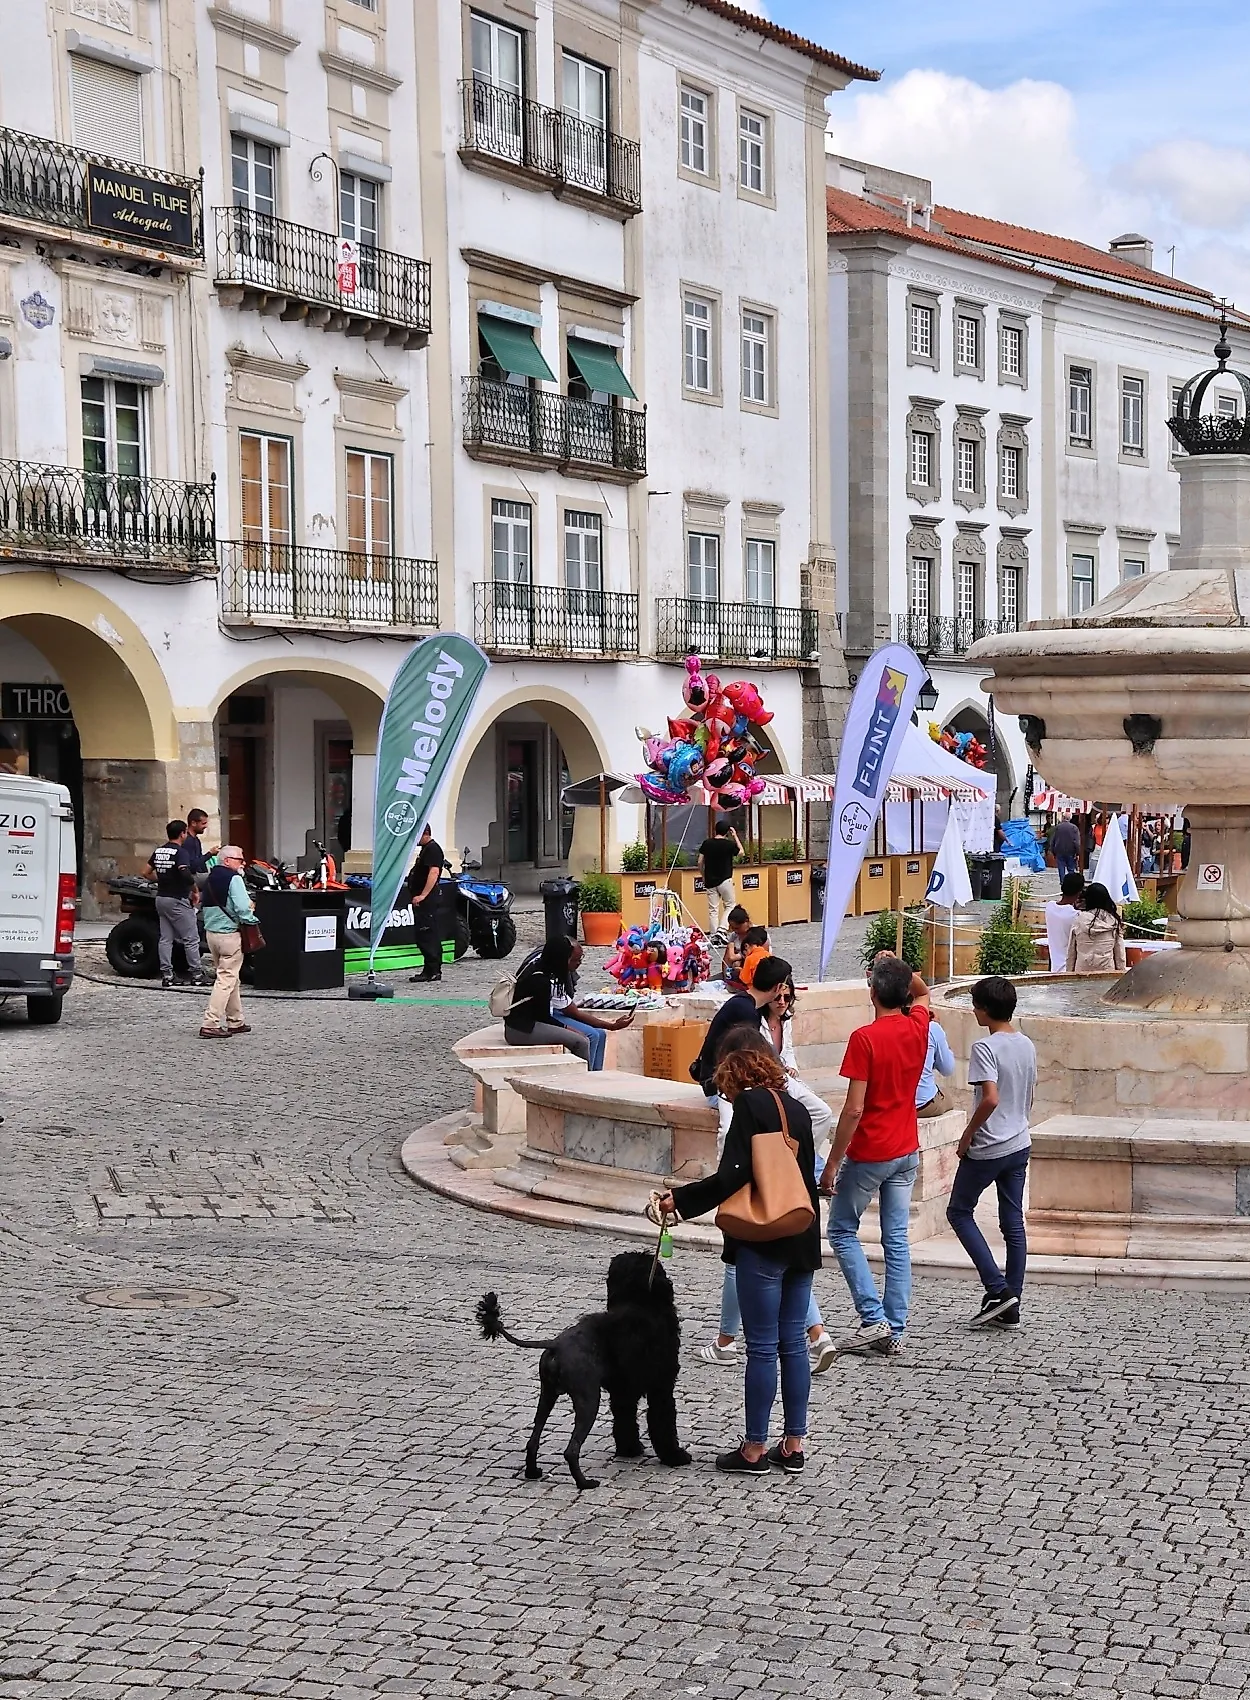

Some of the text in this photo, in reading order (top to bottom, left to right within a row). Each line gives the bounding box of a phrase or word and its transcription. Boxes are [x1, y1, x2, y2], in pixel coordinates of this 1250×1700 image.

[93, 177, 188, 215] MANUEL FILIPE
[112, 208, 172, 231] Advogado
[396, 650, 464, 797] Melody
[859, 709, 891, 788] FLINT
